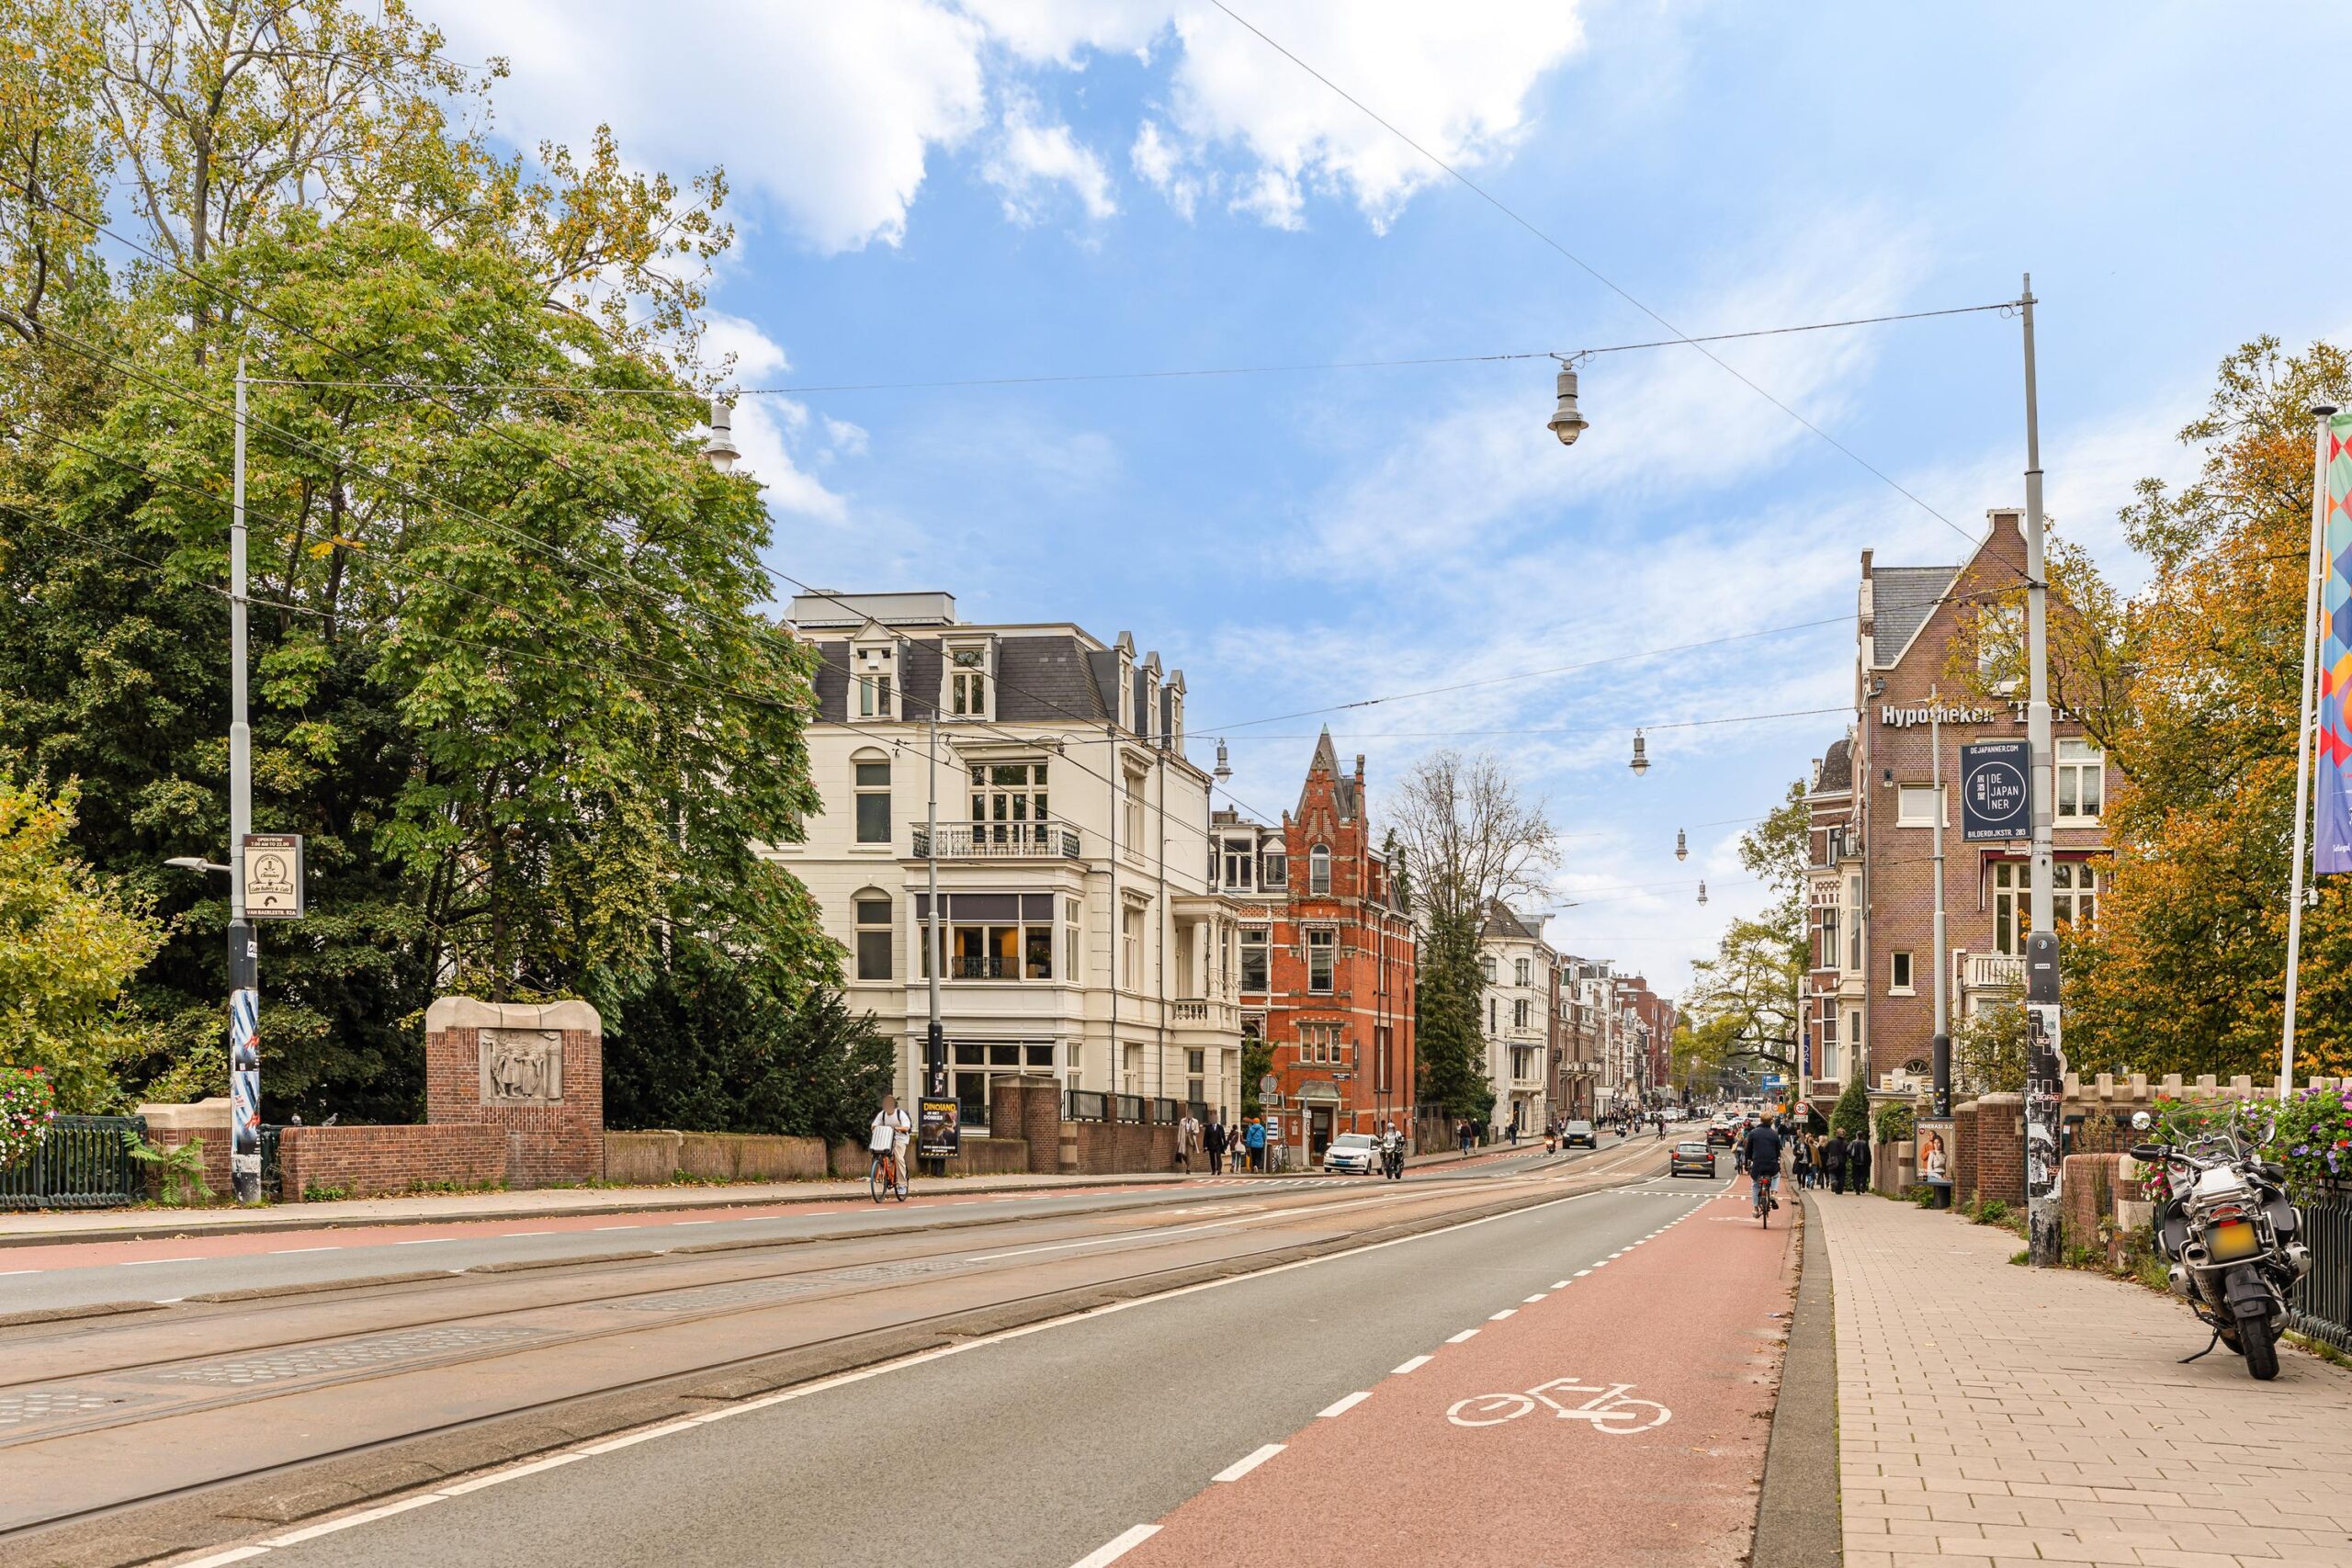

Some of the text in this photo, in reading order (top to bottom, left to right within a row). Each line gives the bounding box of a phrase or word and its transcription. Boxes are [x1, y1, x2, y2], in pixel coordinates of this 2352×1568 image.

[1991, 773, 2002, 784] DE
[1990, 785, 2018, 796] JAPAN
[1991, 799, 2009, 809] NER
[923, 1102, 956, 1111] DINOLAND
